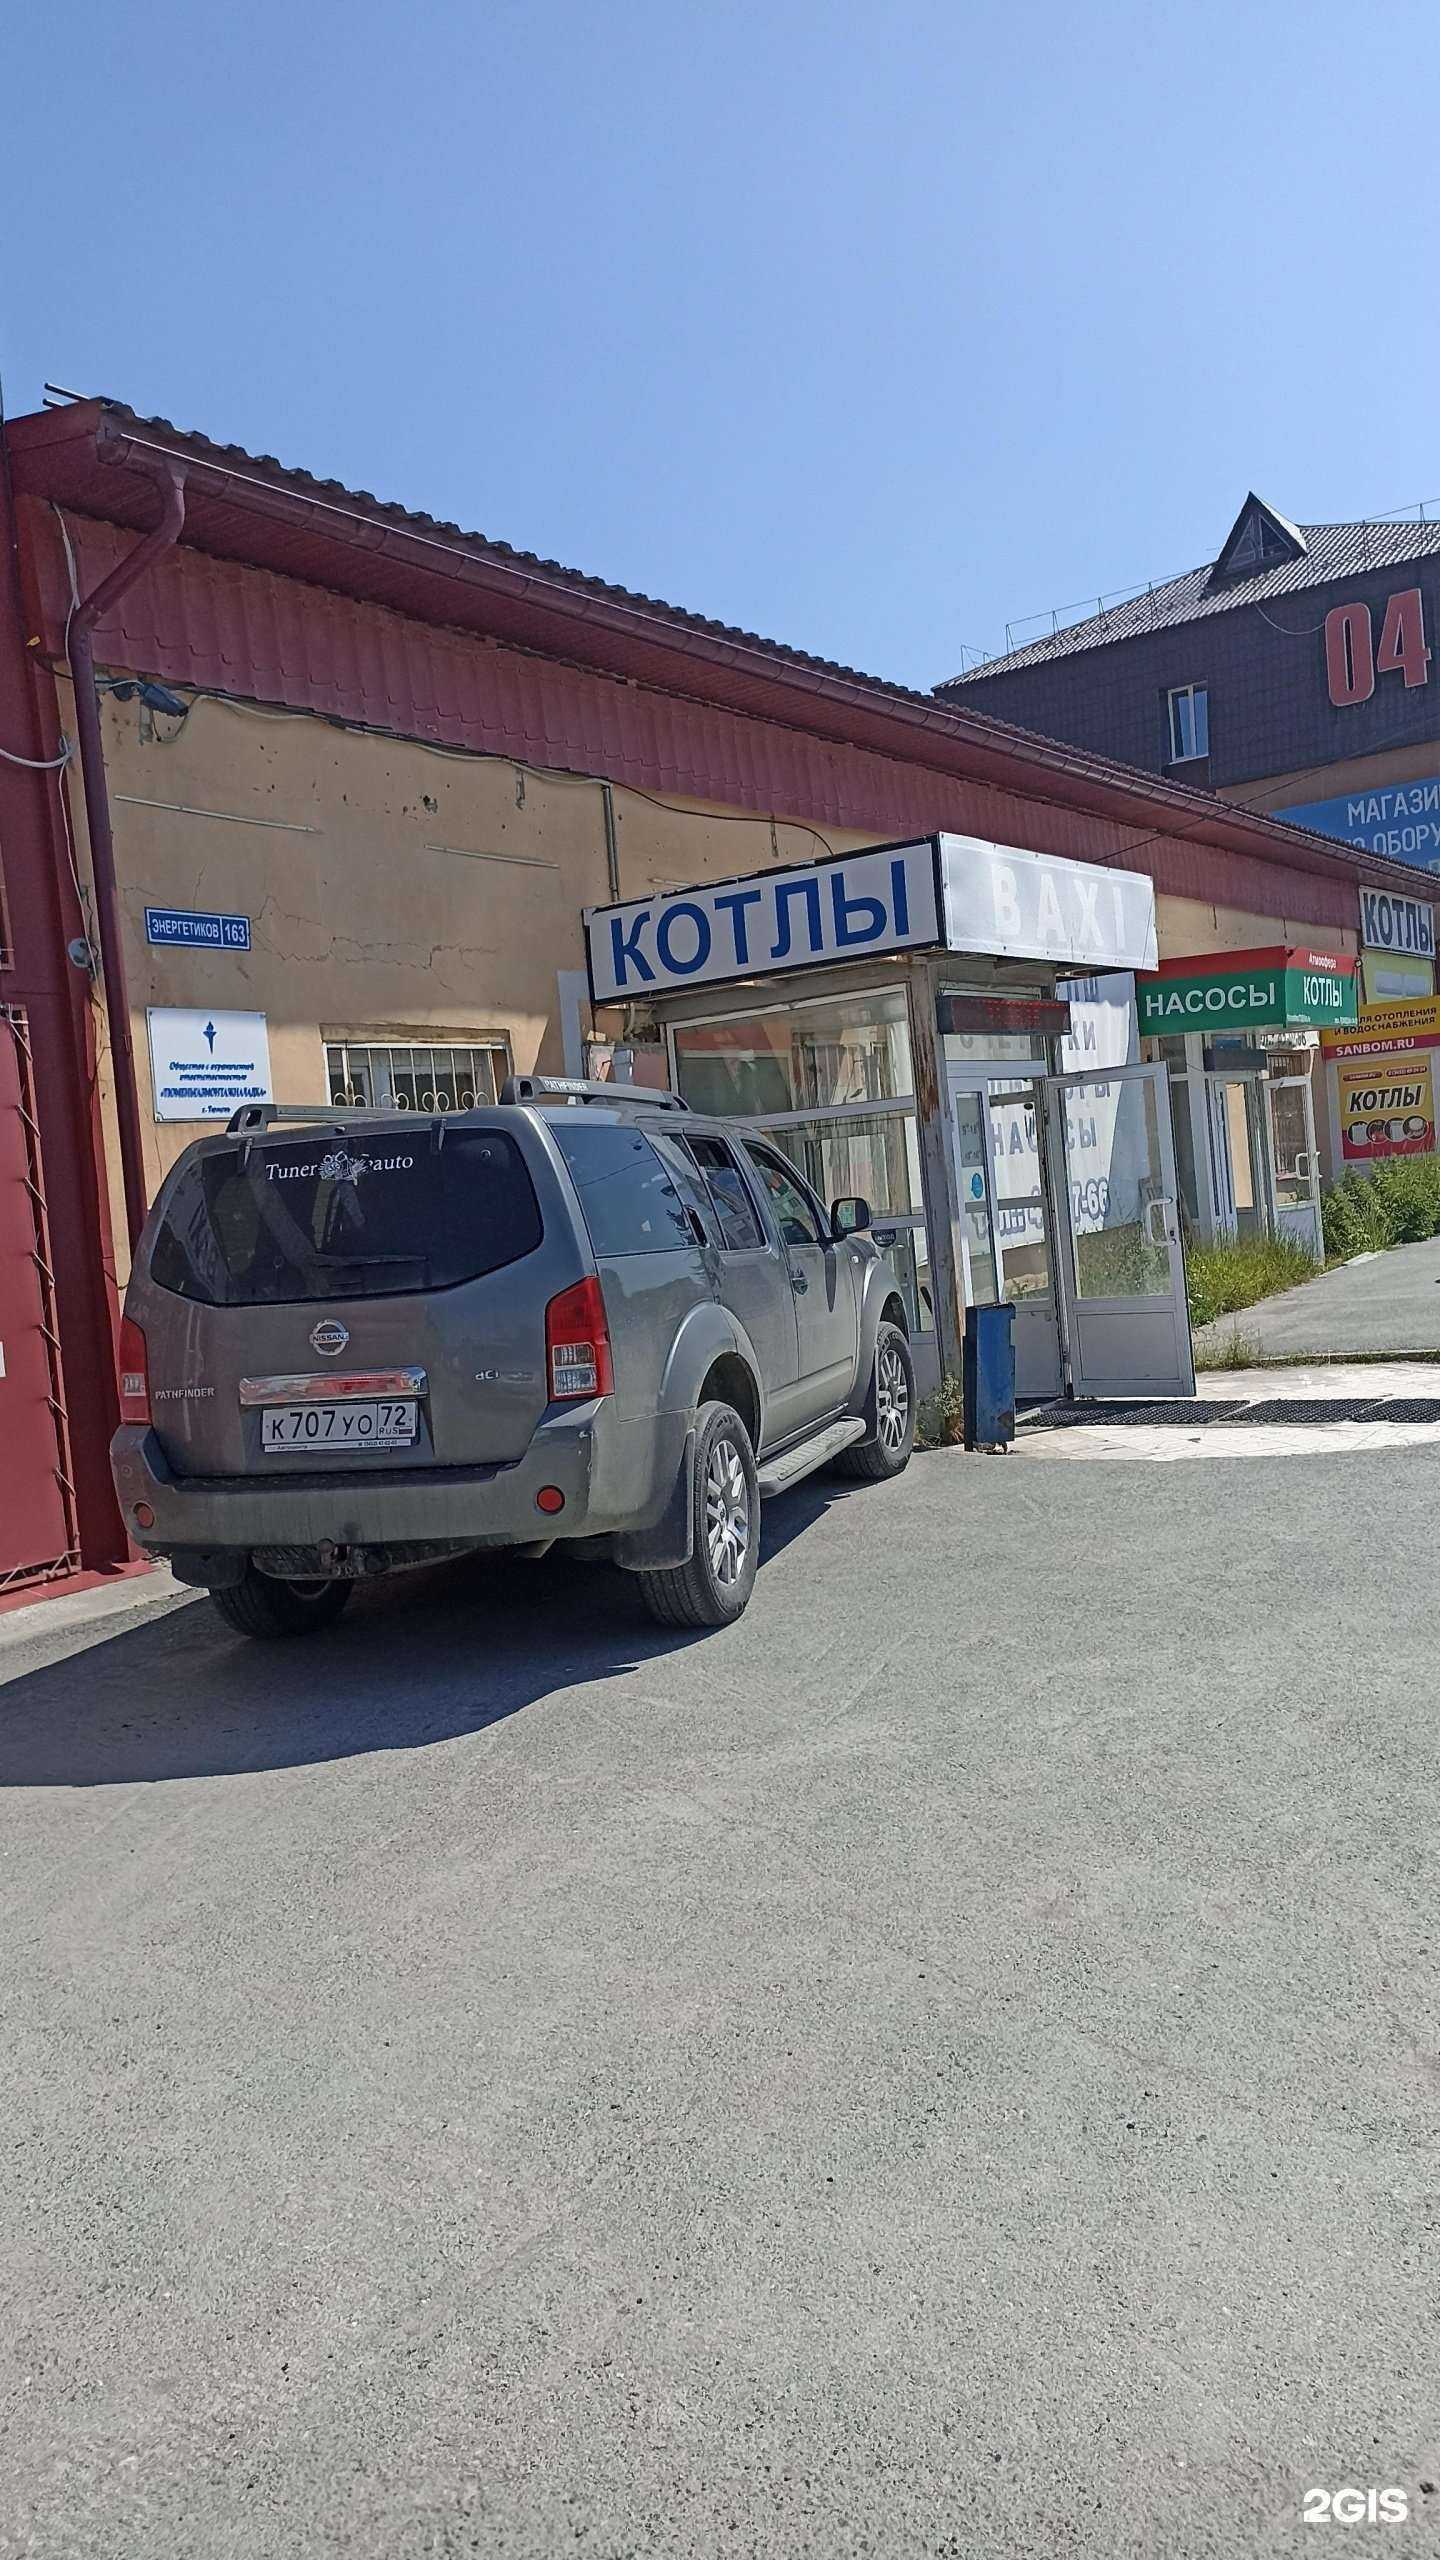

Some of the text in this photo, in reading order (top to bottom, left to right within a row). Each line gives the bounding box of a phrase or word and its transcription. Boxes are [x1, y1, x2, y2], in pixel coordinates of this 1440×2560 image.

[1325, 588, 1432, 706] 04
[1347, 784, 1440, 826] МАГАЗИ
[992, 864, 1126, 953] BAXI
[152, 918, 246, 942] ЭНЕРГЕТИКОВ 163
[611, 860, 909, 986] КОТЛЫ
[1363, 892, 1433, 952] КОТЛЫ
[1146, 982, 1275, 1016] НАСОСЫ
[1303, 976, 1343, 1007] КОТЛЫ
[1343, 1016, 1435, 1035] ВОДОСНАБЖЕНИЯ
[1359, 1015, 1372, 1024] ЛЯ
[1374, 1007, 1437, 1022] ОТОПЛЕНИЯ
[1336, 1038, 1415, 1057] SANBOM.RU
[1349, 1085, 1422, 1113] КОТЛЫ
[265, 1163, 318, 1181] Tuner
[312, 1333, 344, 1342] NISSAN
[155, 1387, 215, 1400] PATHFINDER
[380, 1405, 407, 1427] 72
[378, 1425, 399, 1436] RUS
